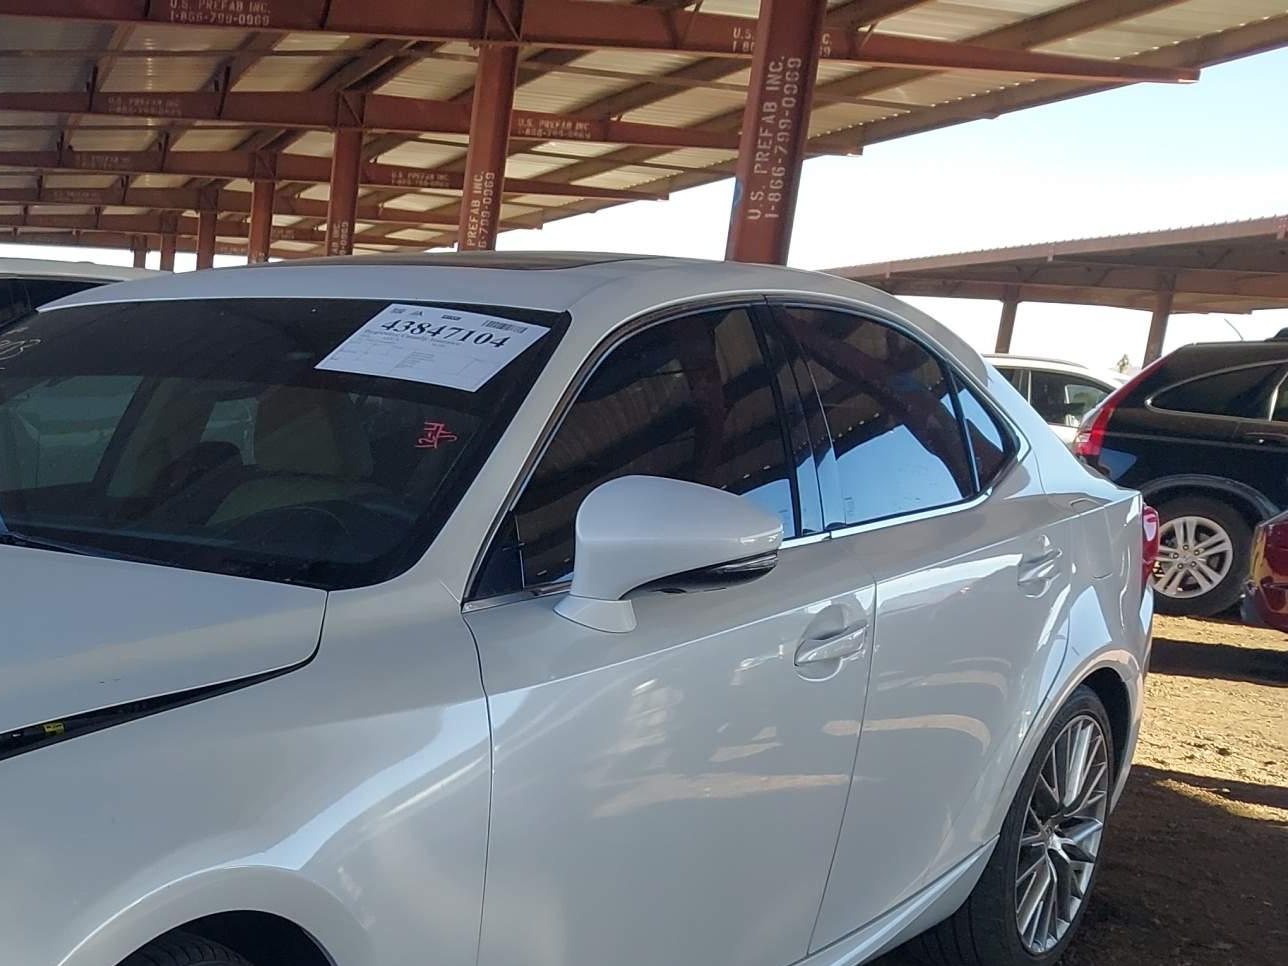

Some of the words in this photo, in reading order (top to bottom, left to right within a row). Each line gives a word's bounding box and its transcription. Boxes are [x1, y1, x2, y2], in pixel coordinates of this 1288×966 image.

[198, 0, 243, 12] PREFAB
[765, 55, 785, 91] INC.
[753, 101, 778, 174] PREFAB
[764, 57, 803, 219] 1-866-799-0969
[747, 186, 766, 220] U.S.
[467, 199, 481, 247] PREFAB
[381, 319, 511, 348] 43847104
